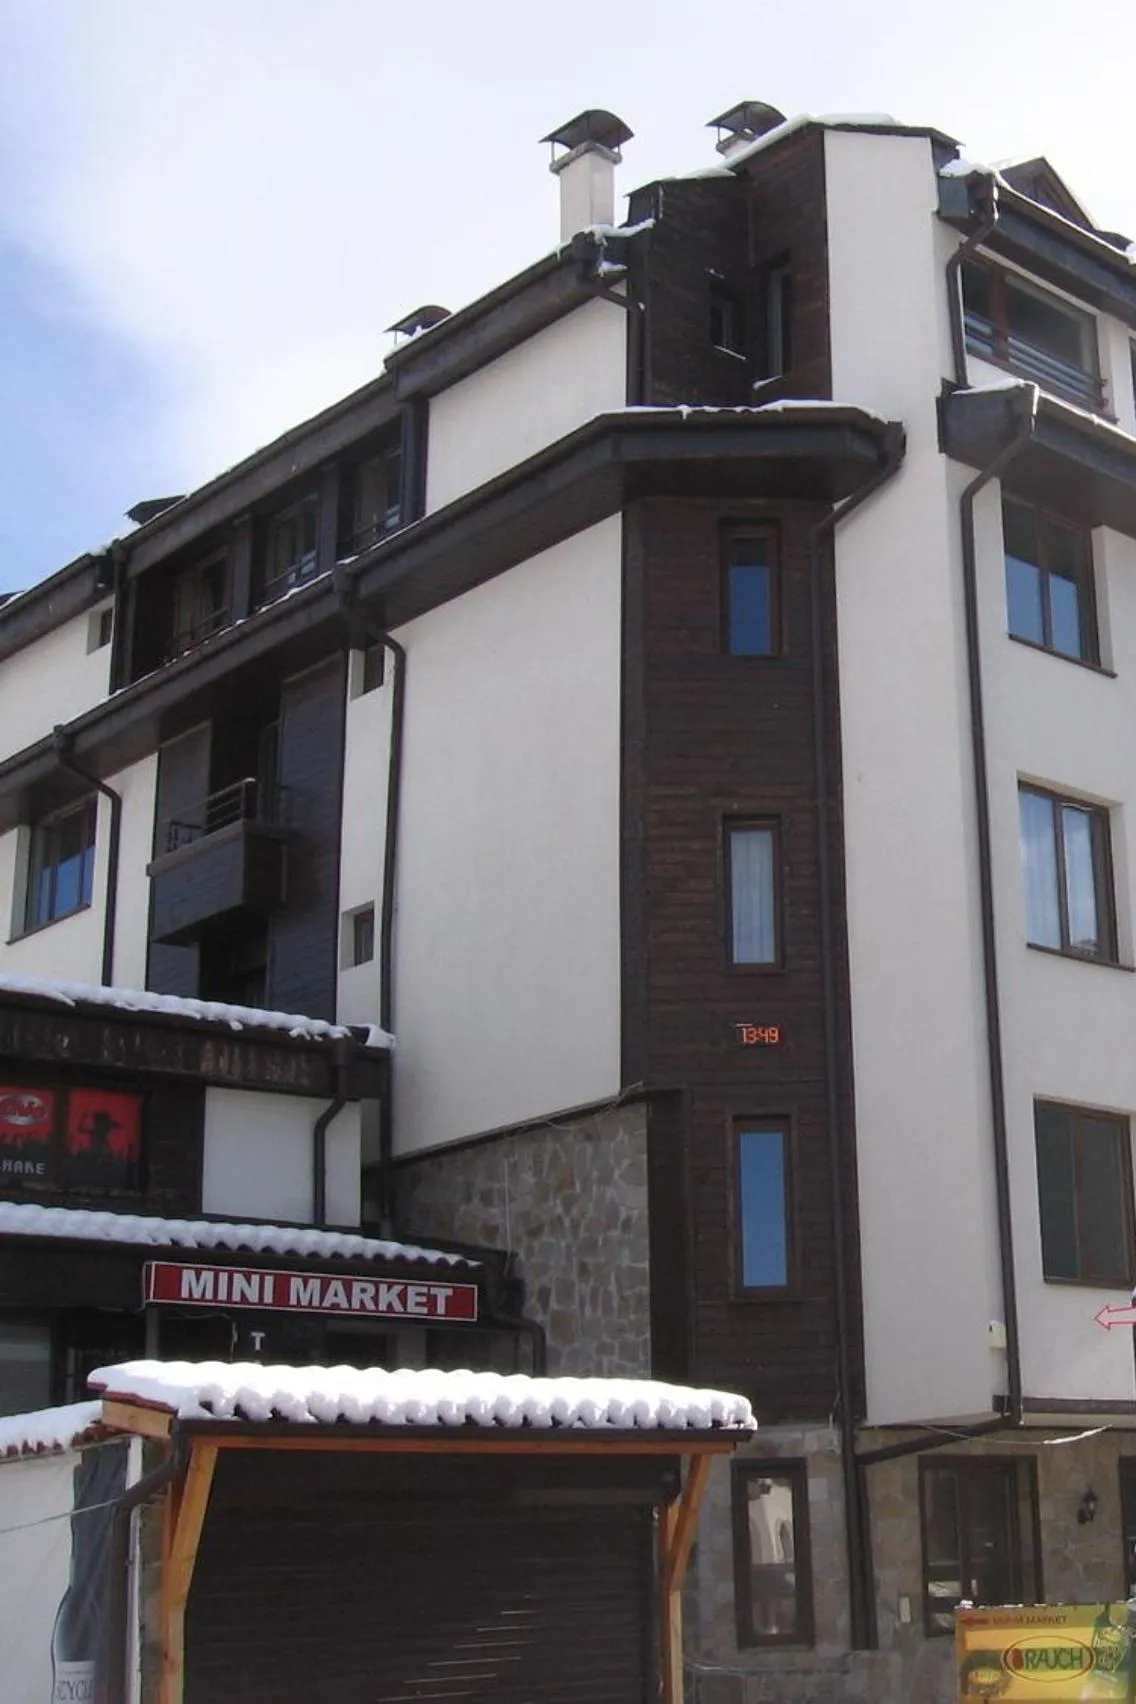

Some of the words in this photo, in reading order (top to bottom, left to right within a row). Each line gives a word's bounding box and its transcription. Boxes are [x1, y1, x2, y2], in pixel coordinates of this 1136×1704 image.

[180, 1268, 275, 1304] MINI
[289, 1277, 453, 1315] MARKET
[1024, 1647, 1084, 1669] RAUCH
